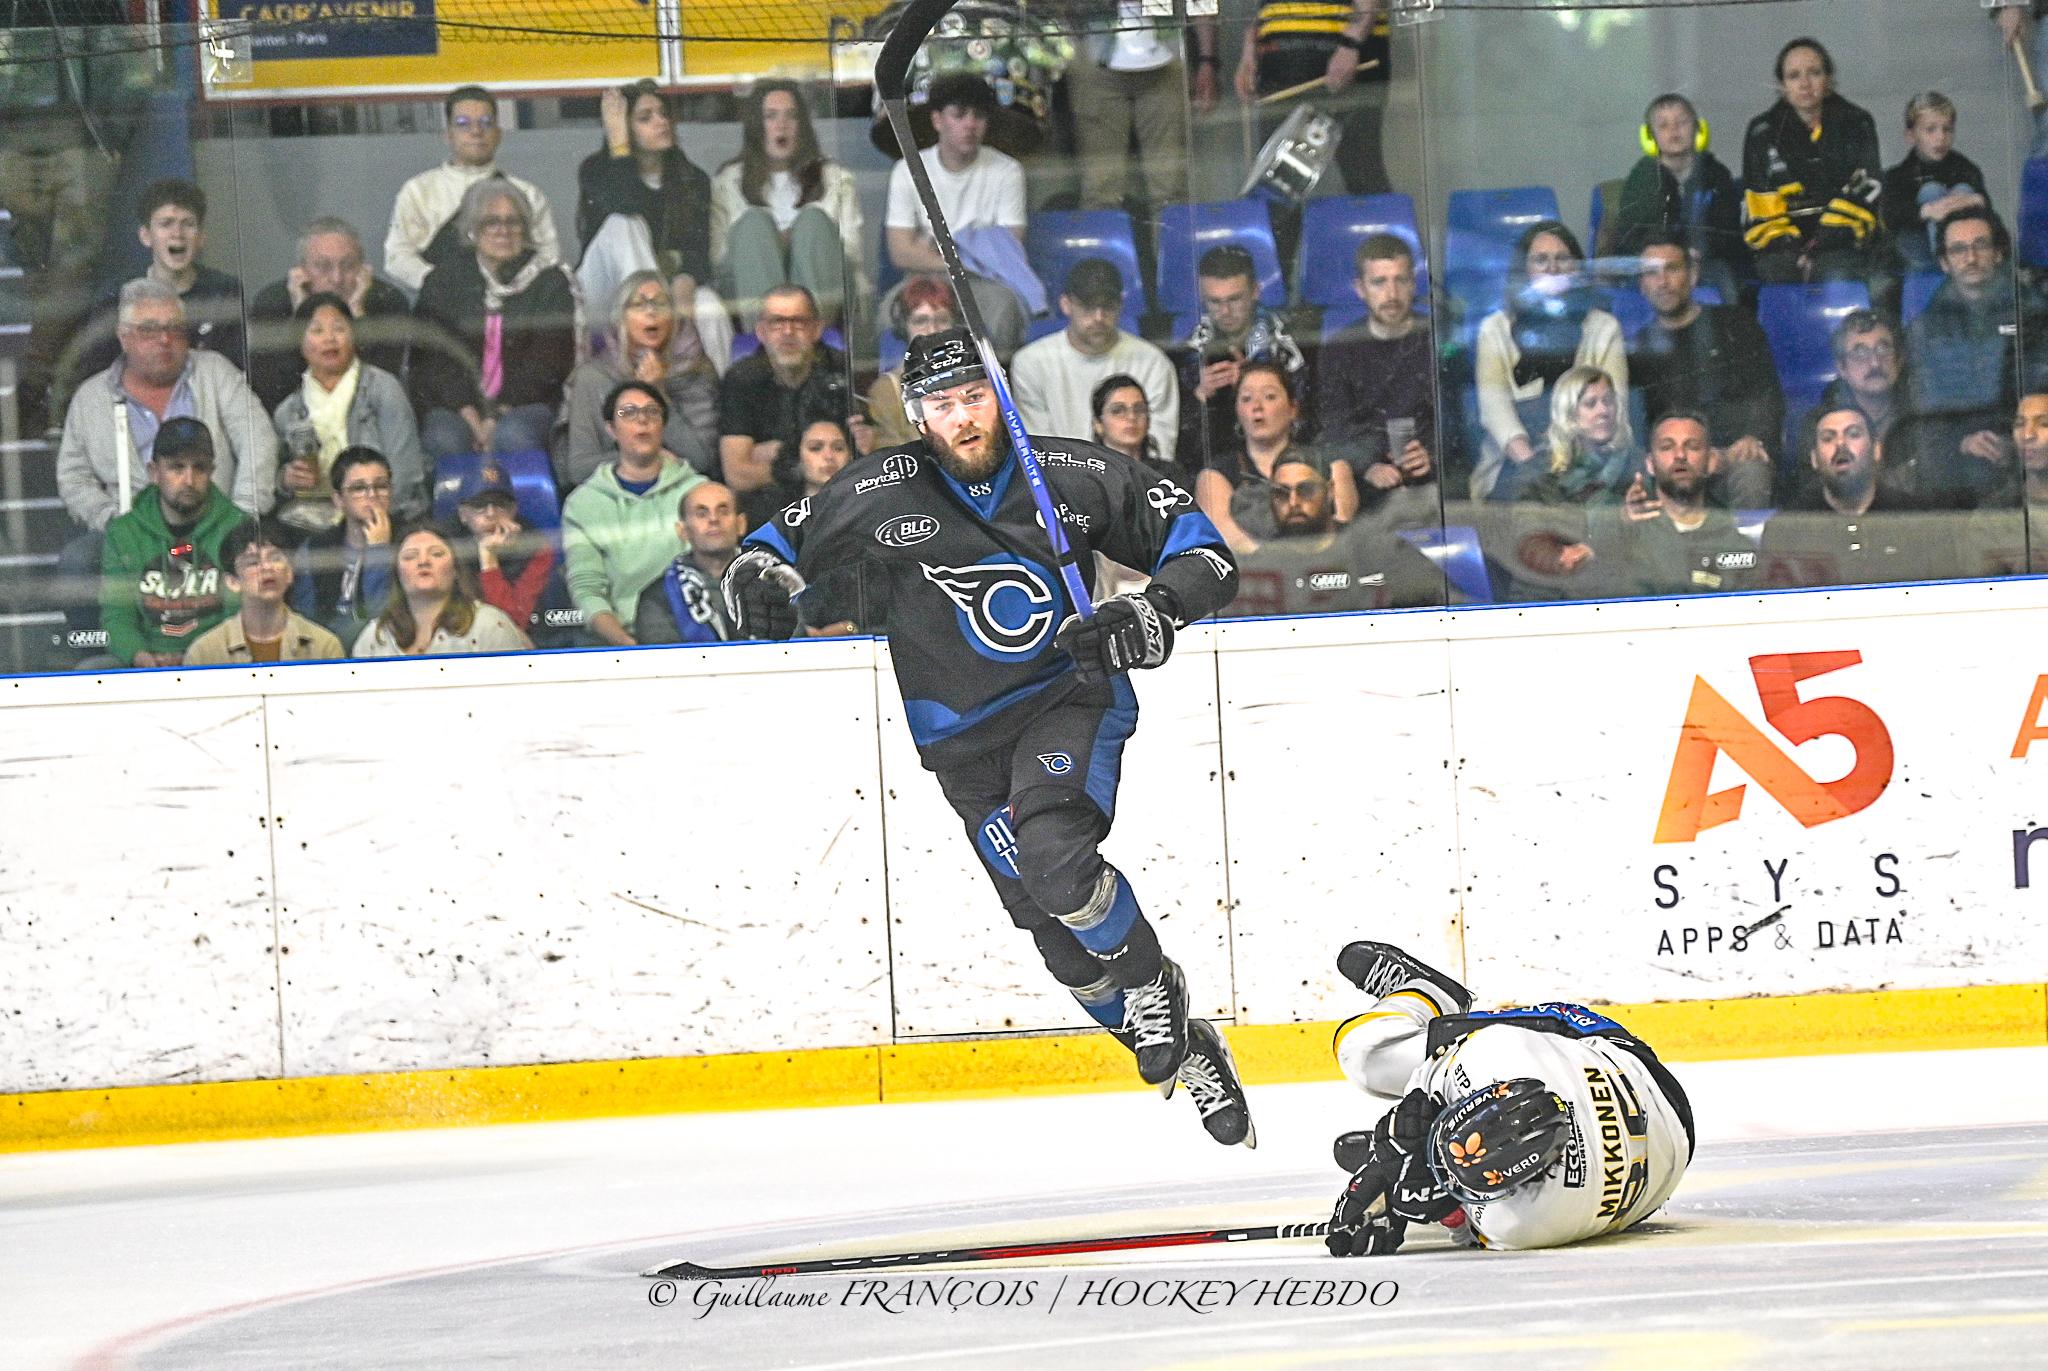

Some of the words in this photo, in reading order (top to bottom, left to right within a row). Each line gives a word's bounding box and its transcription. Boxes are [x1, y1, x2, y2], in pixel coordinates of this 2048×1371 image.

[1006, 410, 1041, 487] HYPERLITE
[901, 519, 931, 536] BLC
[1657, 925, 1748, 956] APPS
[1774, 923, 1794, 950] &
[1818, 918, 1903, 948] DATA
[1454, 1063, 1471, 1090] BTP
[1584, 1067, 1624, 1218] MIKKONEN
[1503, 1153, 1540, 1177] VERD
